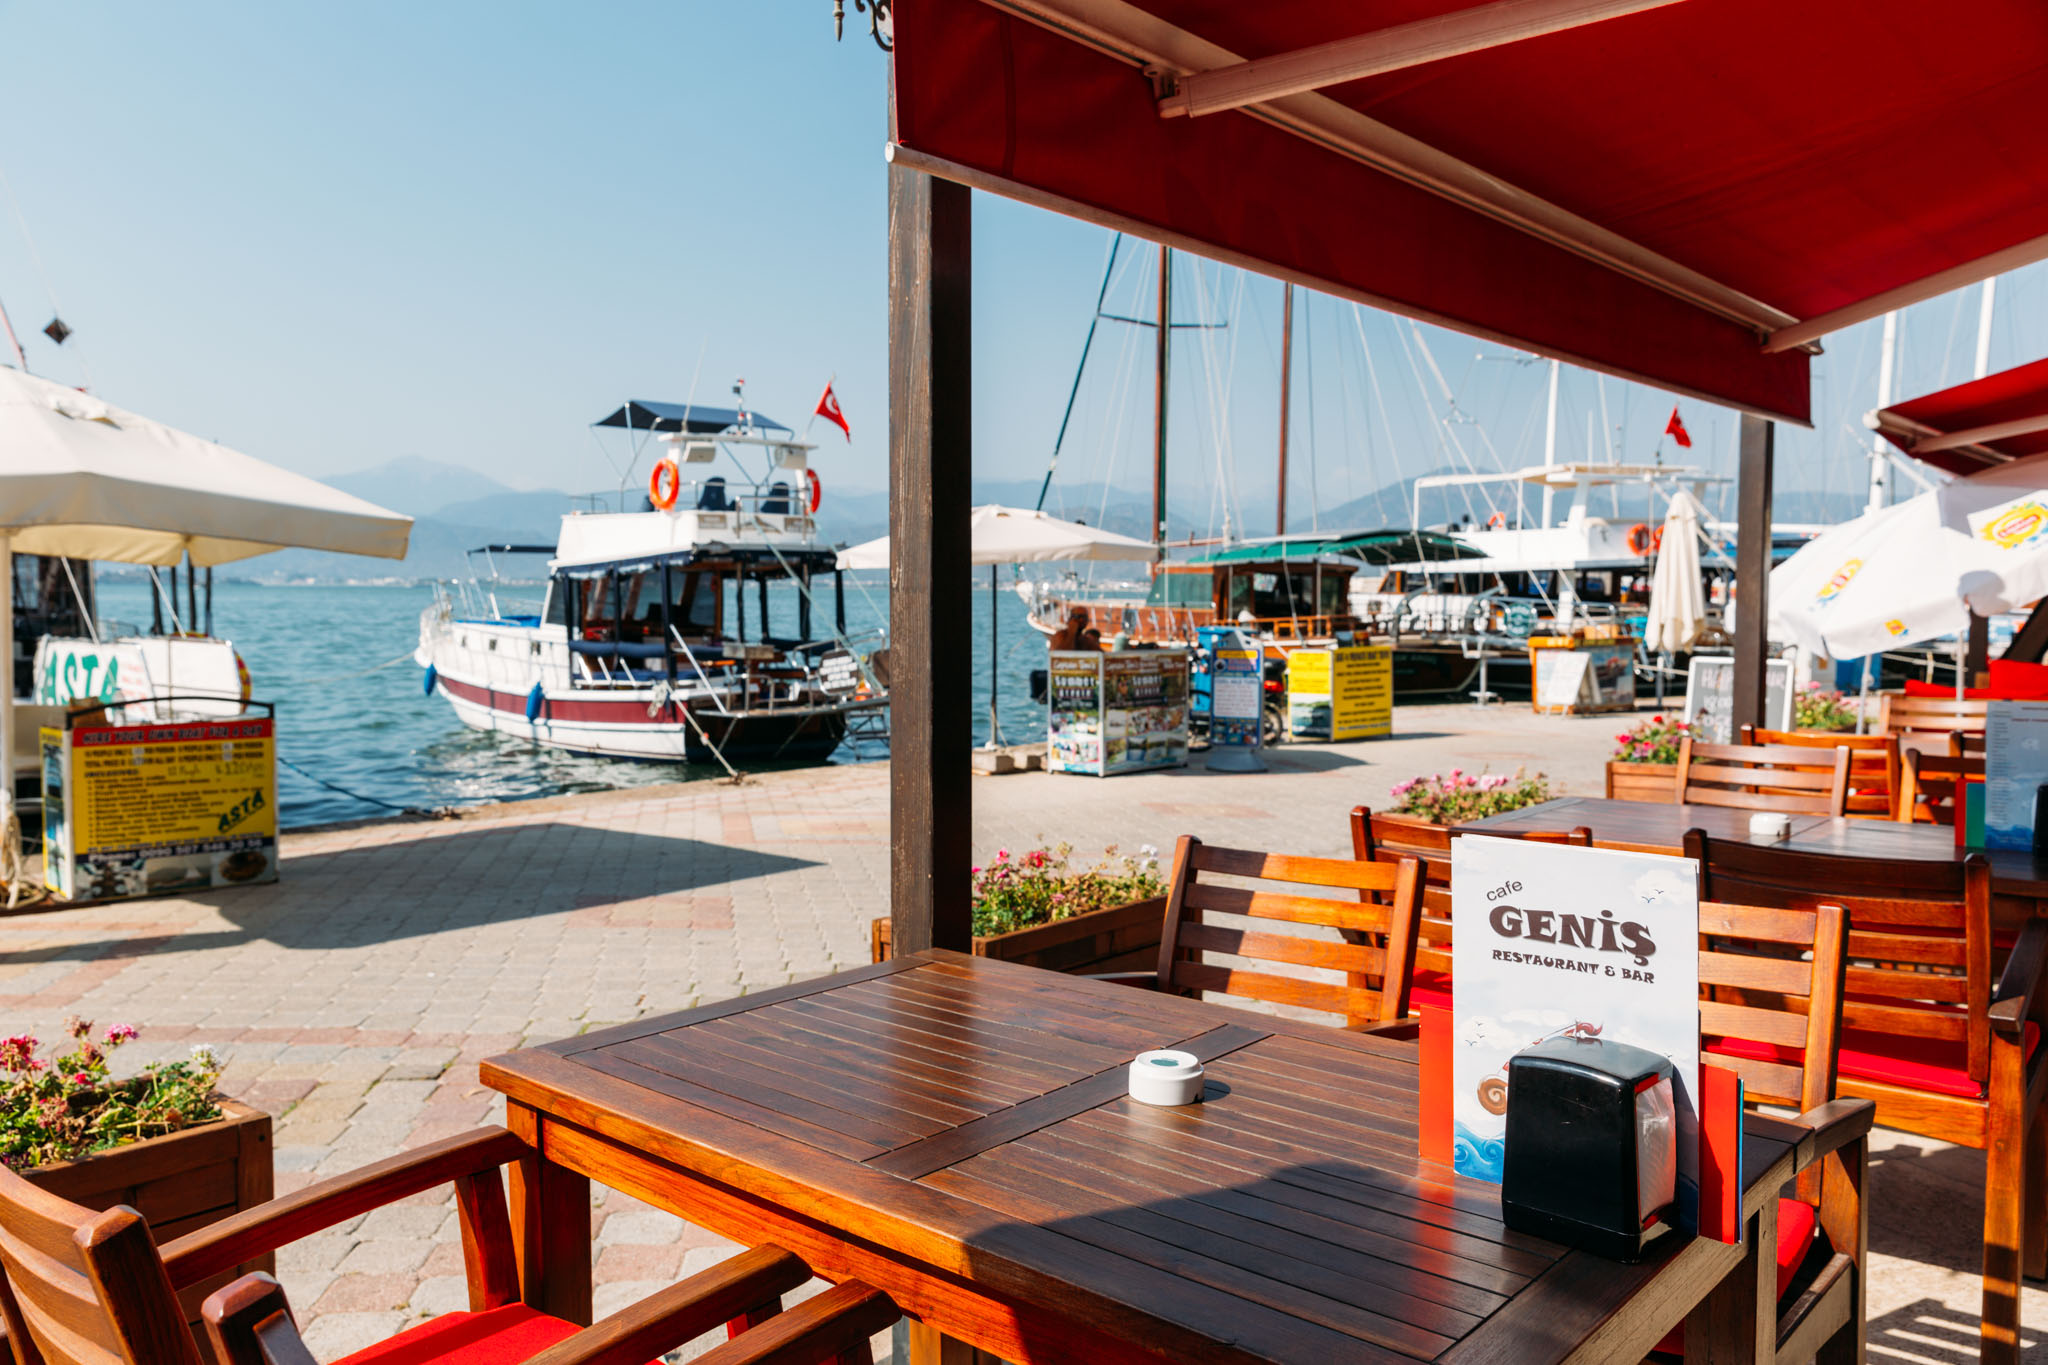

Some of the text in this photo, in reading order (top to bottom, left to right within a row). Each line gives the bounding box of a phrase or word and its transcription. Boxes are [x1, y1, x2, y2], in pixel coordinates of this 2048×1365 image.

[40, 651, 119, 708] ASTA
[218, 789, 265, 832] ASTA
[1486, 880, 1523, 901] cafe
[1489, 905, 1657, 967] GENİŞ
[1492, 949, 1655, 984] RESTAURANT & BAR
